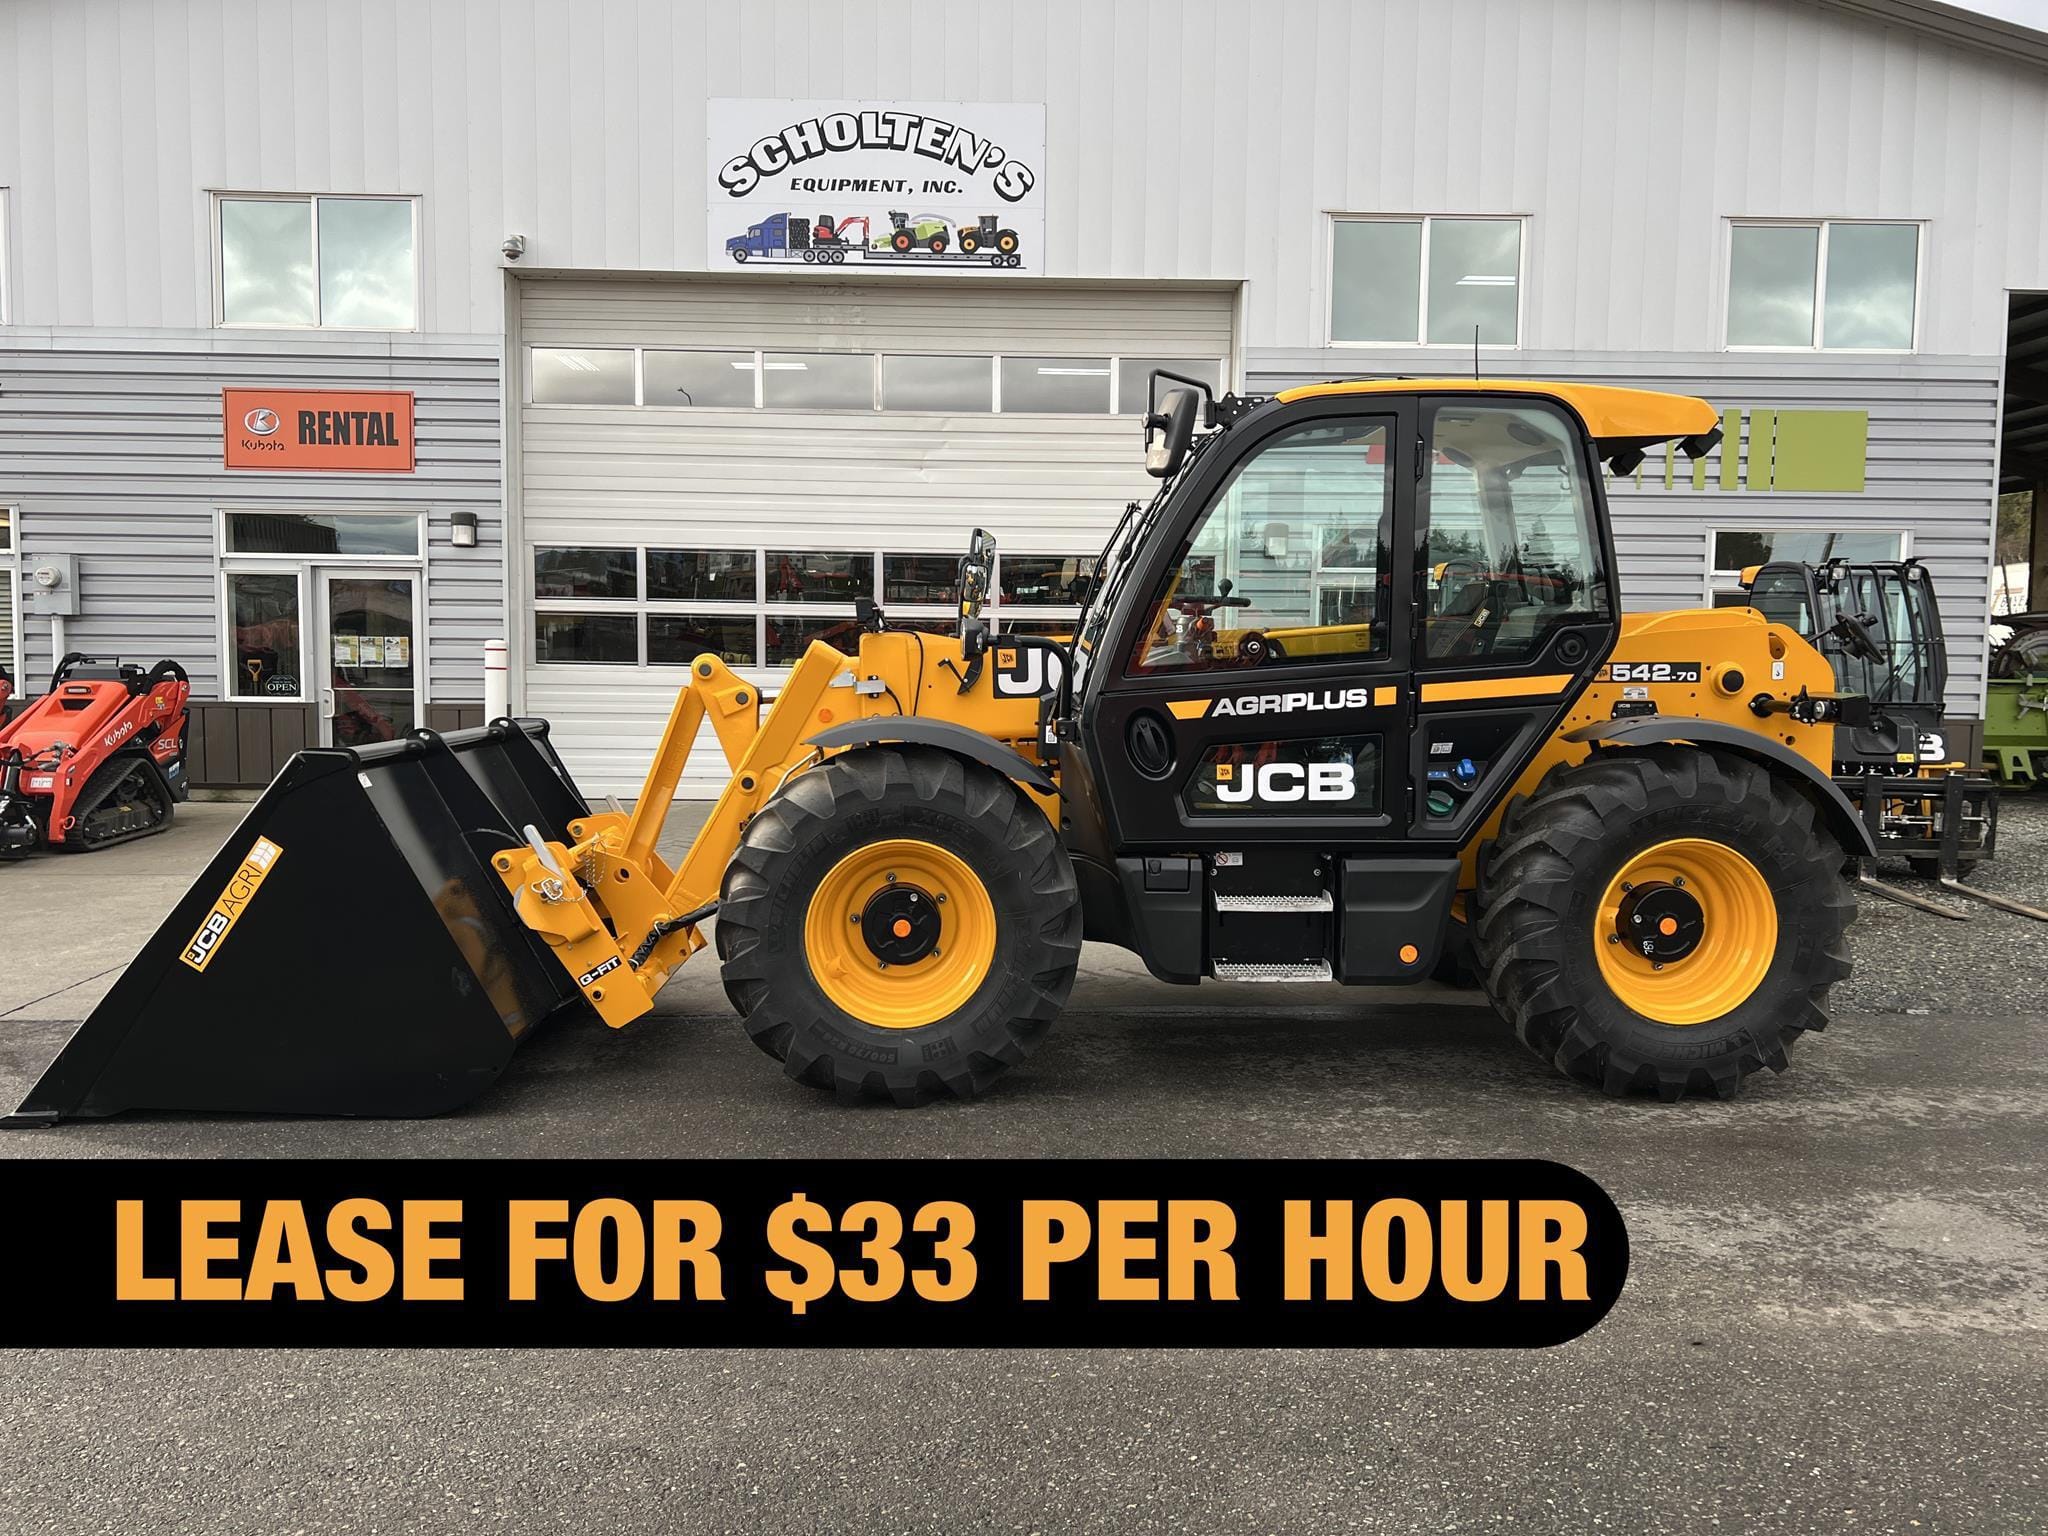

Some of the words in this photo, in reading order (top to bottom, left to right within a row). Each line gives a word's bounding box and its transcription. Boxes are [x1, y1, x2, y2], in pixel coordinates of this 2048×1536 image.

[718, 111, 1035, 202] SCHOLTEN'S
[790, 177, 914, 195] EQUIPMENT,
[922, 180, 964, 194] INC.
[298, 410, 399, 447] RENTAL
[241, 439, 286, 451] Kubota
[267, 683, 297, 691] OPEN
[1211, 688, 1368, 718] AGRIPLUS
[104, 720, 133, 747] Kubota
[158, 738, 178, 750] SCL
[1216, 762, 1356, 802] JCB
[192, 912, 229, 964] JCB
[222, 863, 263, 916] AGRI
[579, 956, 618, 986] Q-FIT
